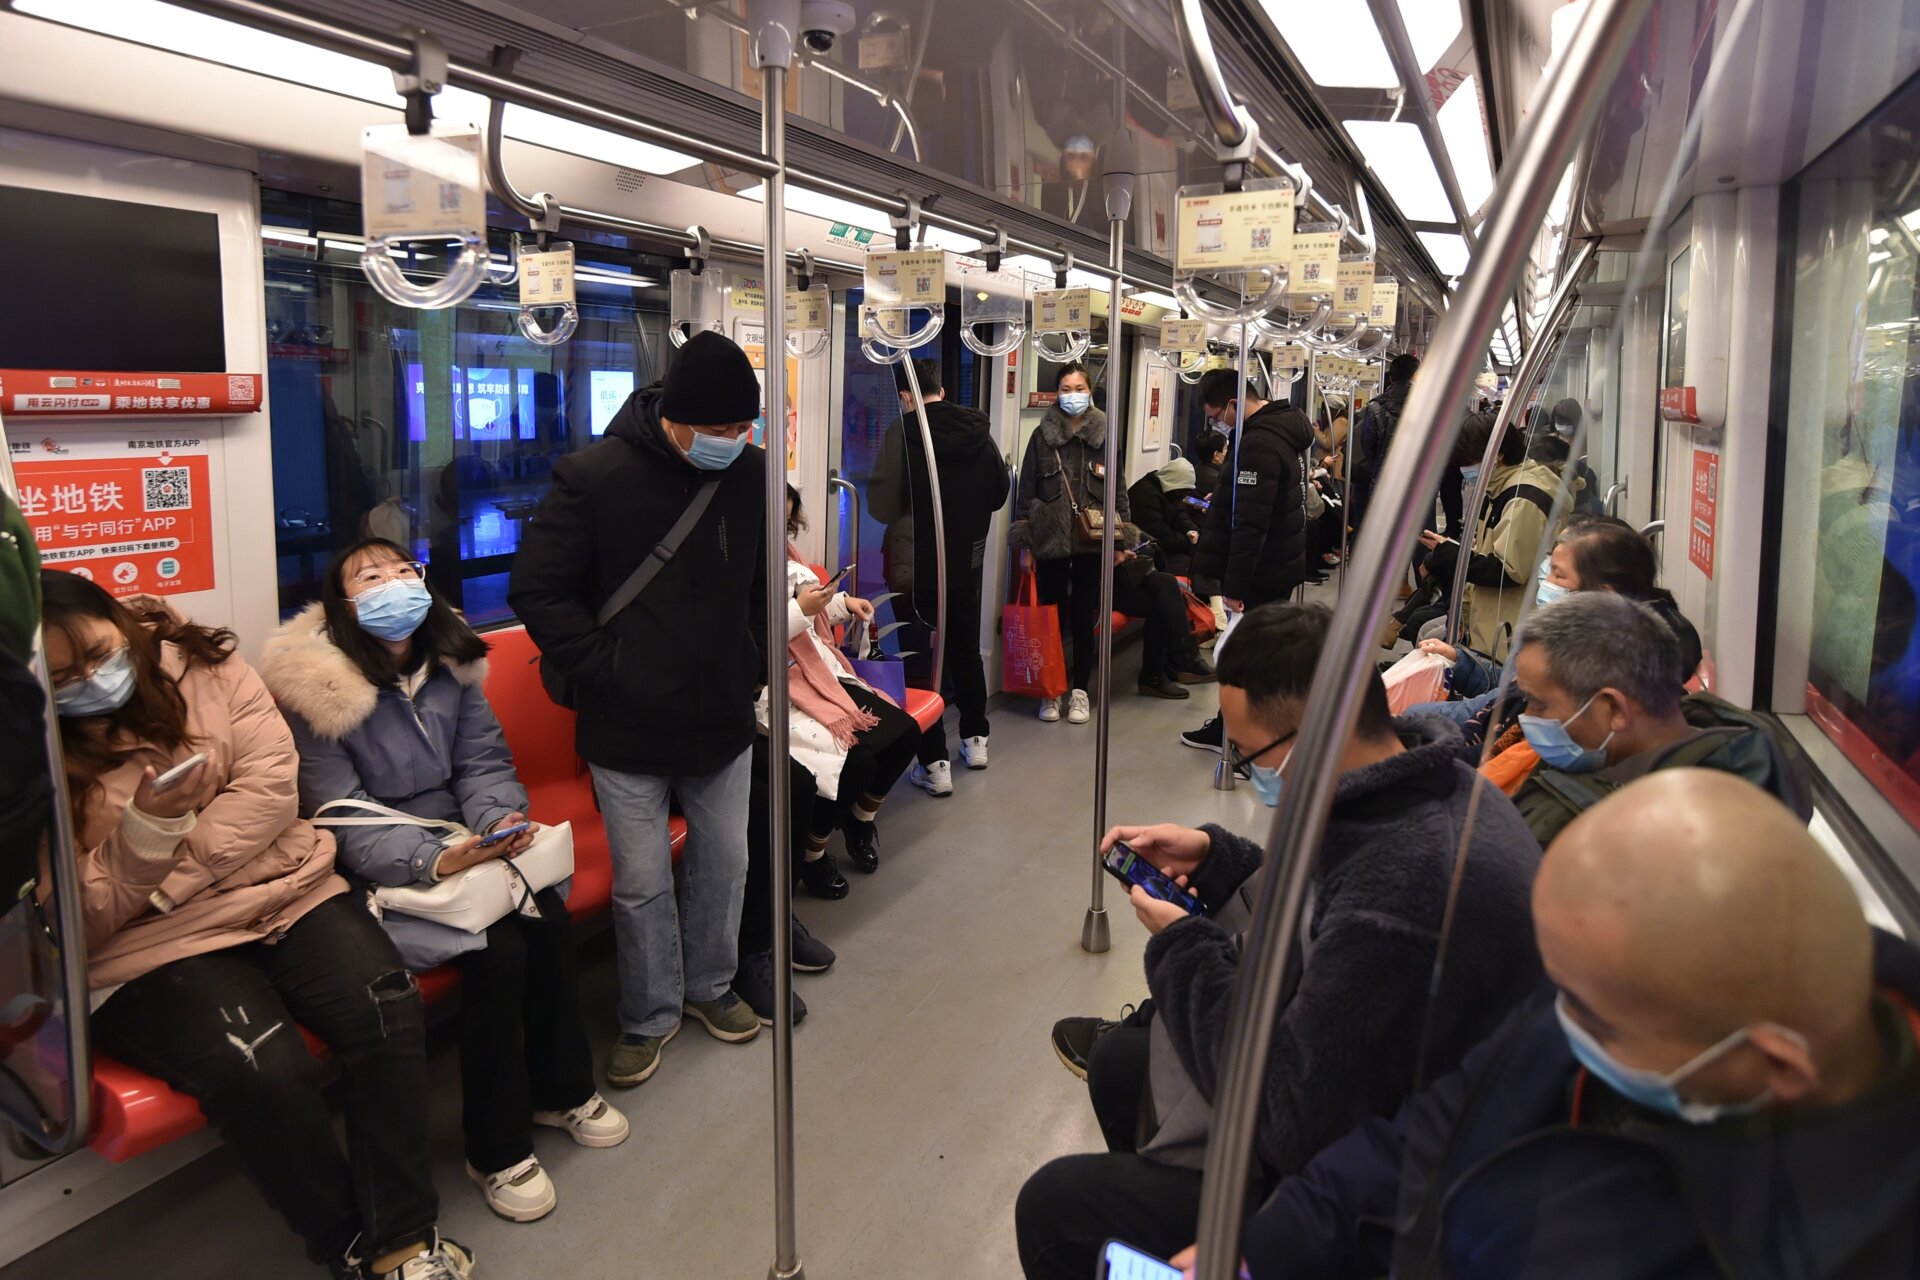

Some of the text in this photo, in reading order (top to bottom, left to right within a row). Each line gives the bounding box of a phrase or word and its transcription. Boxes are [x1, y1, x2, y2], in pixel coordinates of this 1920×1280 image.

[115, 396, 212, 410] 乘地铁享优惠
[127, 438, 201, 450] 南京地铁官方APP
[18, 481, 125, 517] 坐地铁
[101, 541, 175, 555] 快来扫码下载使用吧
